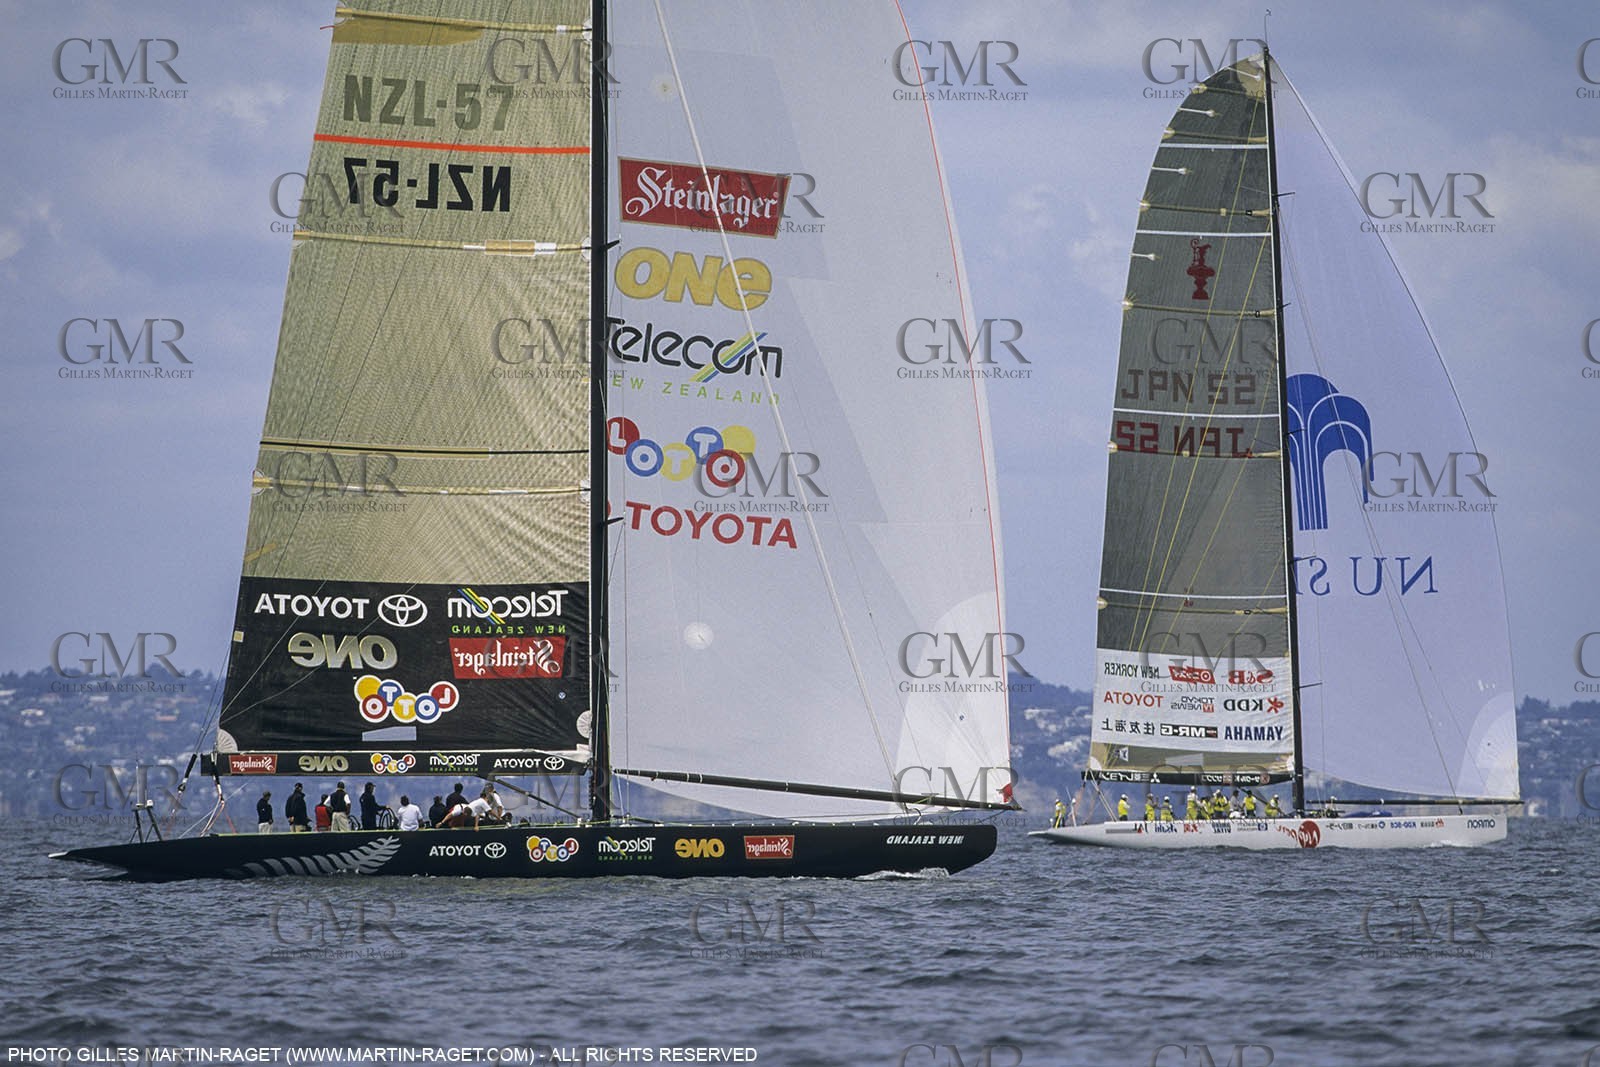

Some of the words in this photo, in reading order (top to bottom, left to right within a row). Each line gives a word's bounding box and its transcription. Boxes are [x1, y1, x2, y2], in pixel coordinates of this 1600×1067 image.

[343, 75, 514, 131] NZL-57
[625, 166, 778, 228] Steinlager
[612, 374, 645, 390] EW
[662, 381, 780, 406] ZEALAND
[1121, 369, 1194, 402] JPN
[1208, 374, 1256, 405] 52
[626, 501, 798, 549] TOYOTA
